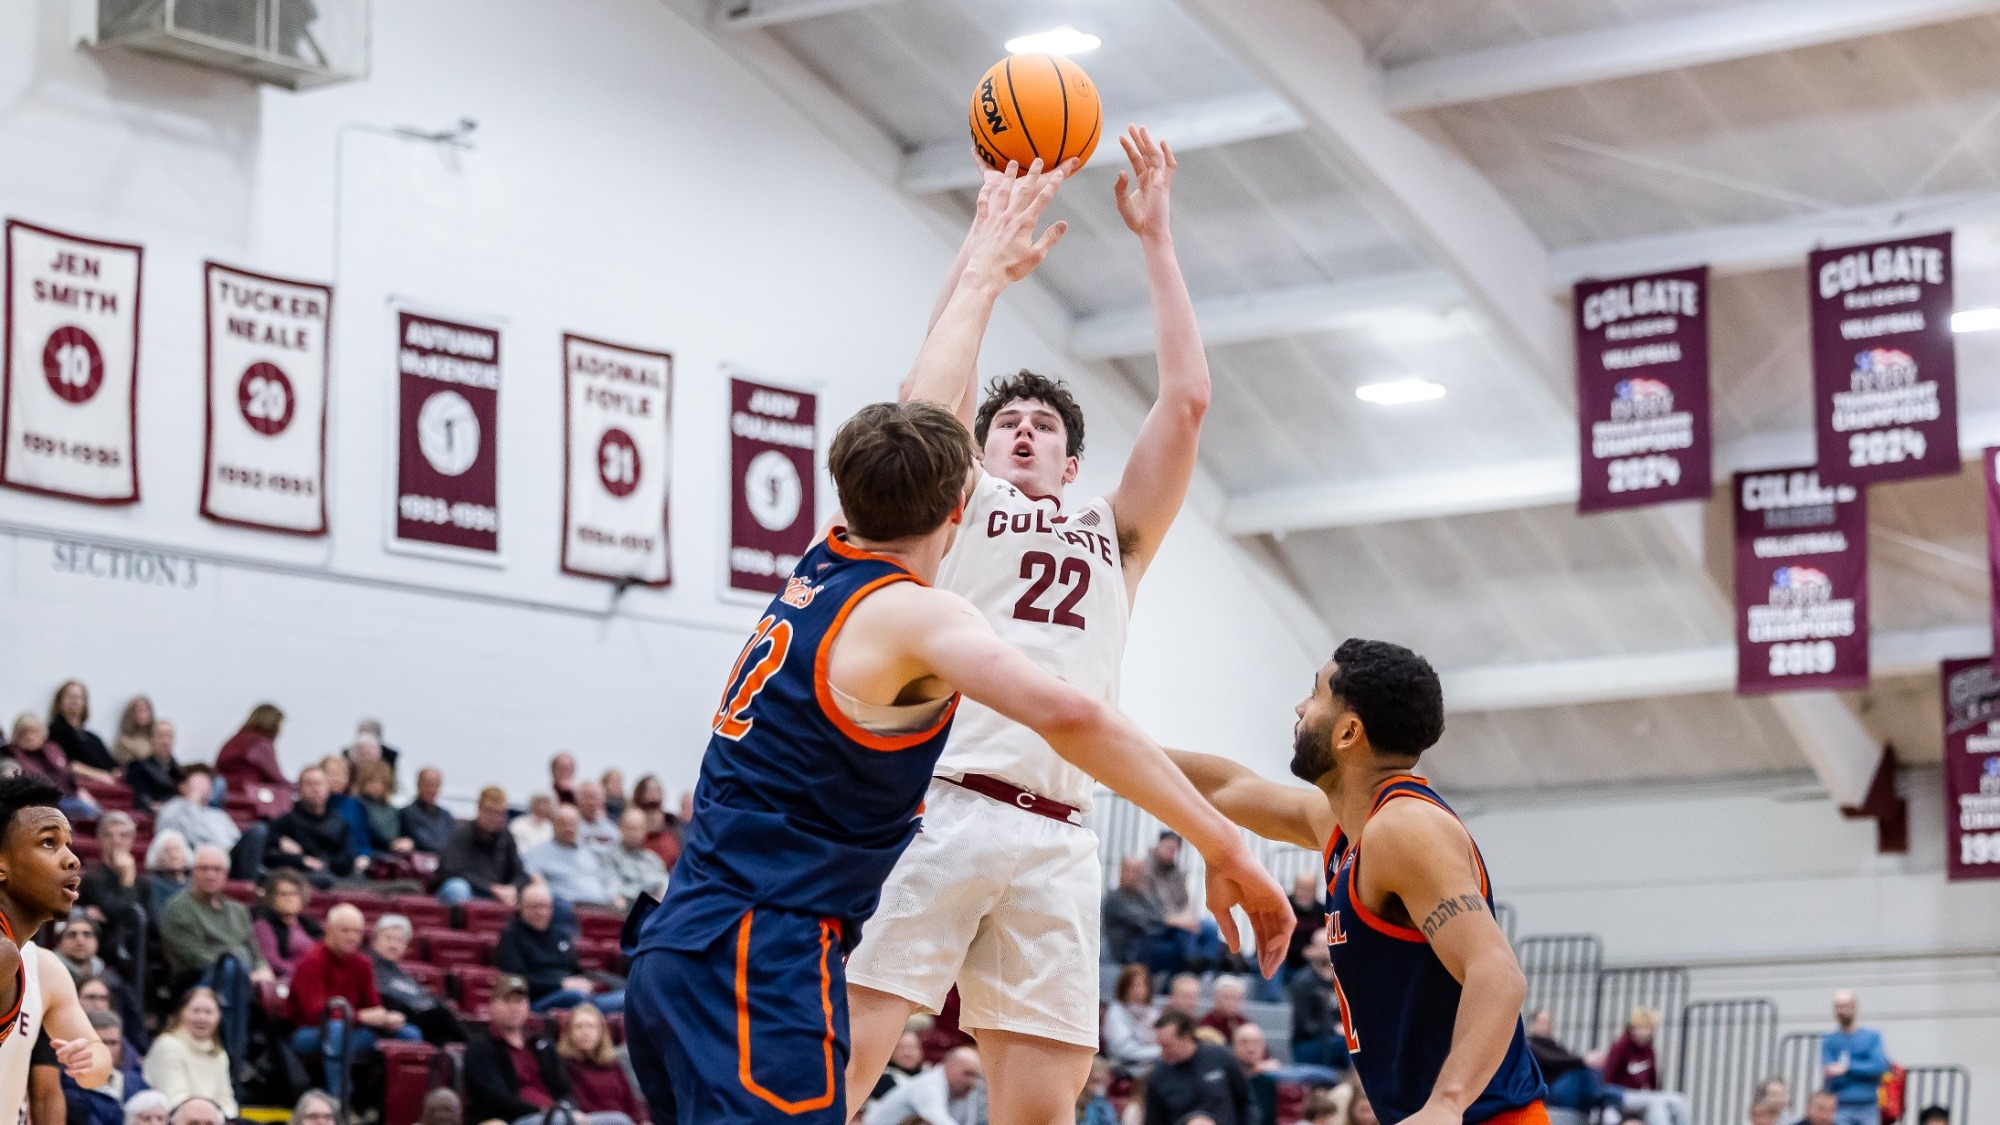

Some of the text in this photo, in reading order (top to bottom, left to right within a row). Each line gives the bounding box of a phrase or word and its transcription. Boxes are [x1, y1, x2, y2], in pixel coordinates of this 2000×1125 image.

[981, 75, 1008, 136] NCAA
[50, 251, 102, 278] JEN
[1819, 245, 1943, 299] COLGATE
[33, 280, 119, 314] SMITH
[218, 280, 323, 319] TUCKER
[1583, 280, 1699, 330] COLGATE
[227, 316, 310, 353] NEALE
[56, 342, 92, 388] 10
[246, 375, 288, 424] 20
[601, 440, 635, 485] 31
[1848, 427, 1927, 468] 2024
[1608, 453, 1680, 493] 2024
[51, 538, 177, 586] SECTION
[1012, 550, 1091, 630] 22
[1768, 640, 1836, 676] 2019
